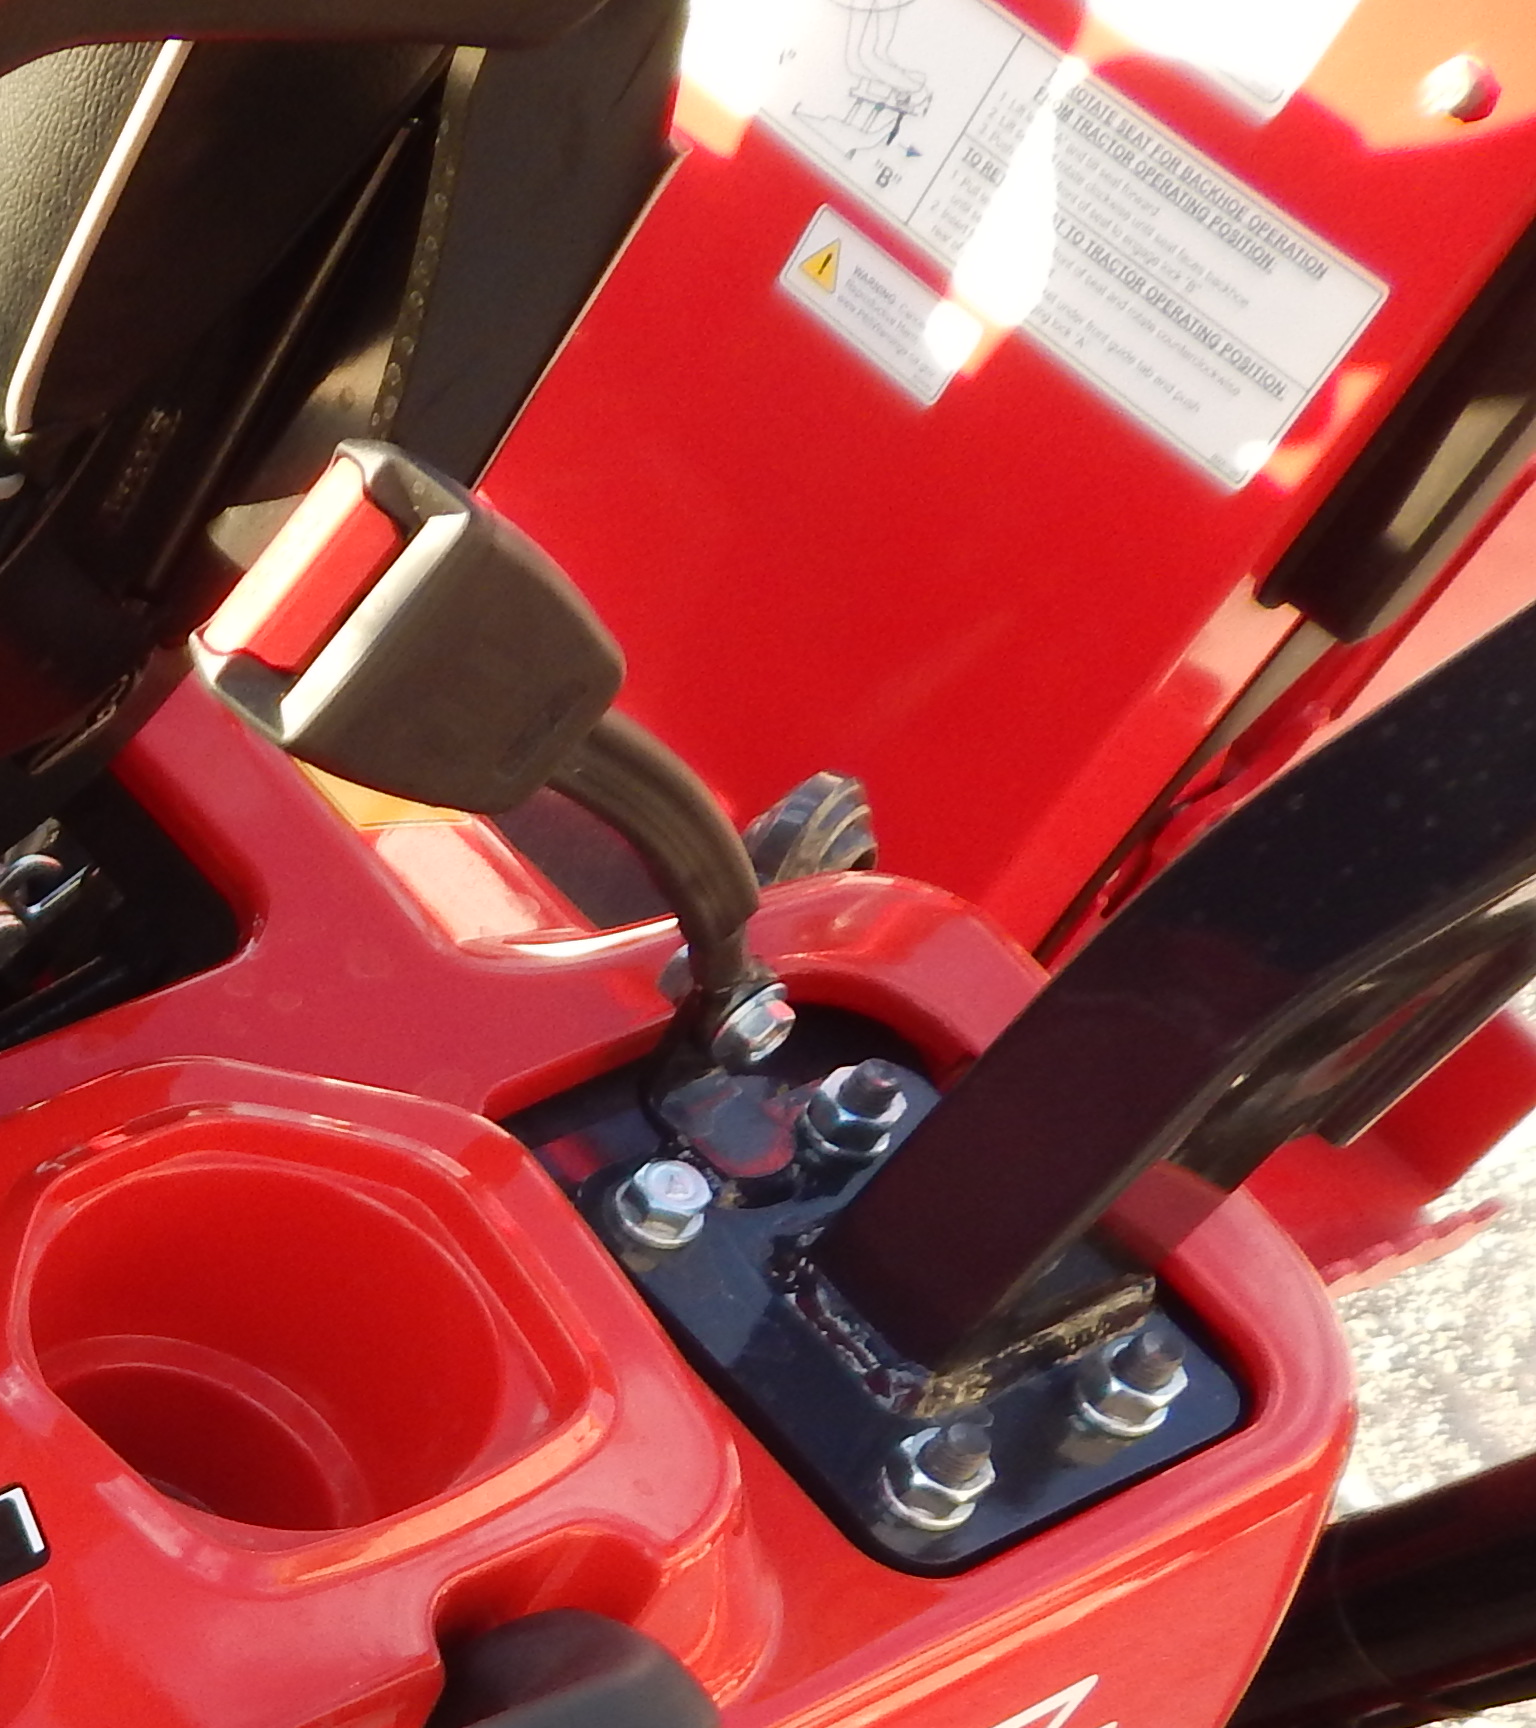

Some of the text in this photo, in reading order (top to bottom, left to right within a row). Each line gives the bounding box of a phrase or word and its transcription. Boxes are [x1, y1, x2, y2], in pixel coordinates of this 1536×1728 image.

[1073, 116, 1136, 168] TRACTOR
[1131, 159, 1211, 224] OPERATING
[1114, 117, 1153, 152] SEAT
[1149, 144, 1182, 173] FOR
[1177, 165, 1248, 223] BACKHOE
[1247, 214, 1329, 279] OPERATION
[1082, 240, 1147, 294] TRACTOR
[1142, 284, 1223, 350] OPERATING
